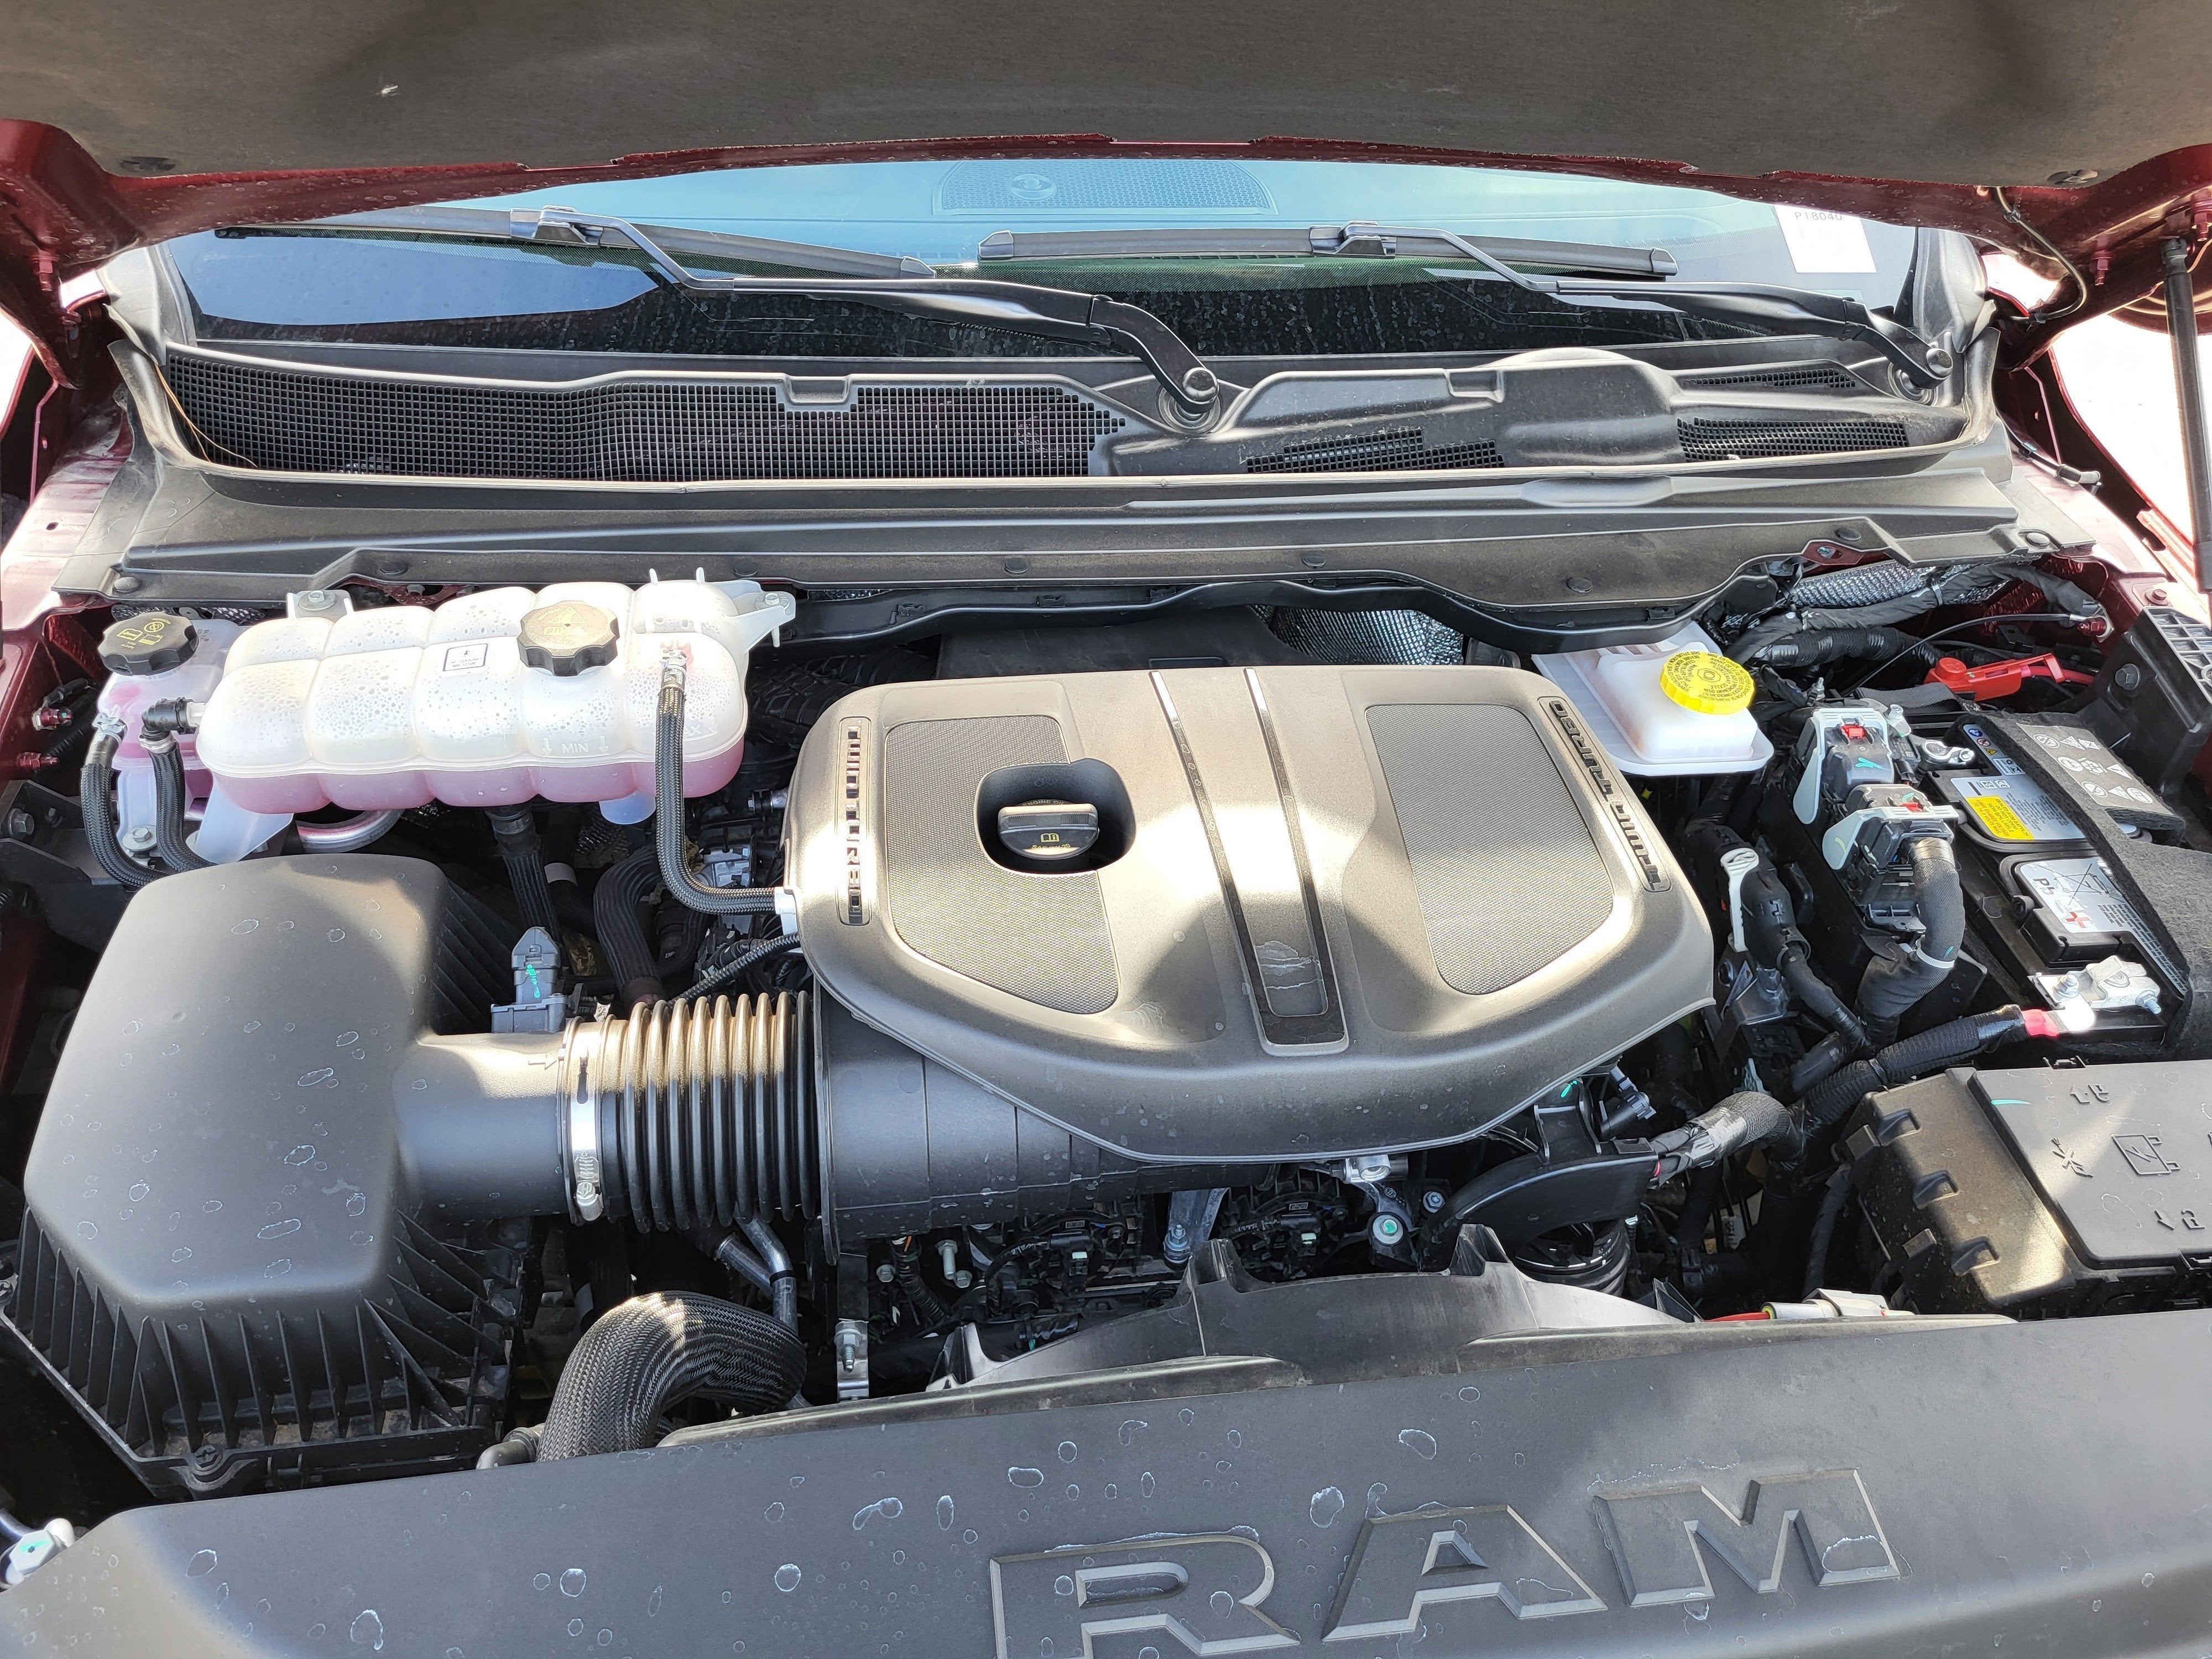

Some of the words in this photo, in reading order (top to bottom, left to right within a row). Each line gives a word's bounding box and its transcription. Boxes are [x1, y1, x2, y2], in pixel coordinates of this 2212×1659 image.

[562, 743, 589, 753] MIN
[1548, 699, 1616, 802] TURBO
[2032, 878, 2056, 895] Pb
[989, 1468, 1901, 1659] RAM
